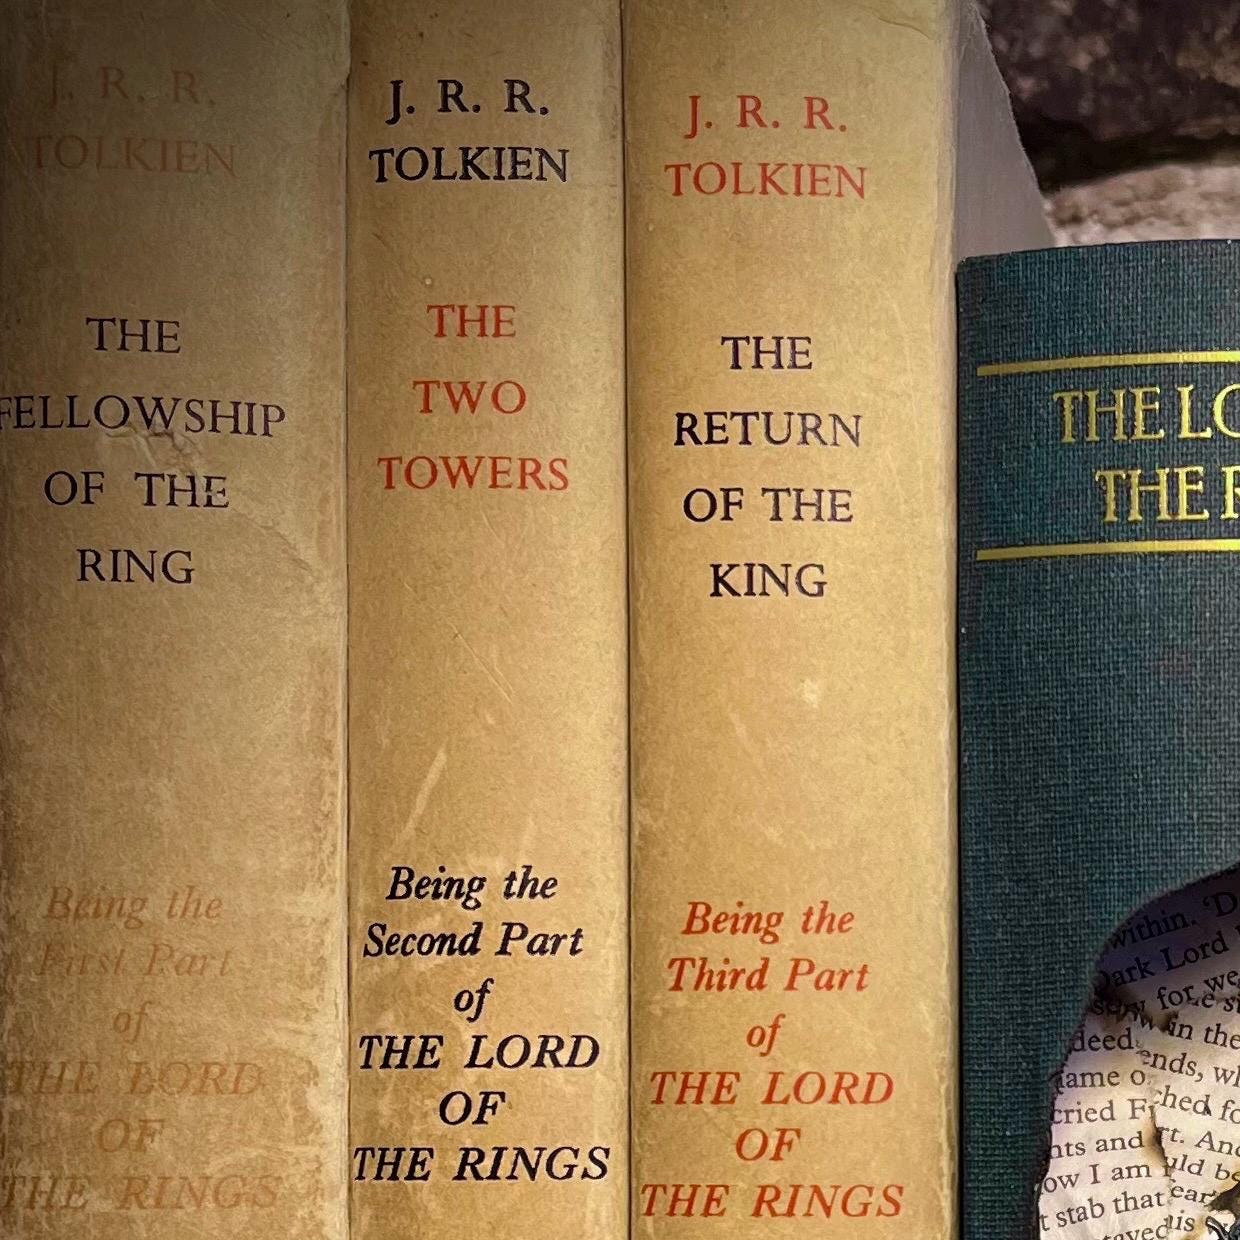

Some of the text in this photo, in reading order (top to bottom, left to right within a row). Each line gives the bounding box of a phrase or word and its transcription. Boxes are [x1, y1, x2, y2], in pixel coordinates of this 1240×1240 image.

[385, 79, 549, 125] J. R. R.
[685, 94, 847, 139] J. R. R.
[34, 135, 237, 176] TOLKIEN
[369, 146, 568, 183] TOLKIEN
[664, 162, 867, 199] TOLKIEN
[86, 317, 181, 355] THE
[426, 304, 517, 338] THE
[721, 335, 813, 371] THE
[412, 380, 526, 415] TWO
[1053, 386, 1165, 444] THE
[673, 411, 862, 447] RETURN
[43, 470, 229, 510] OF THE
[377, 456, 568, 491] TOWERS
[683, 487, 853, 523] OF THE
[1095, 466, 1209, 525] THE
[76, 548, 195, 584] RING
[709, 562, 827, 598] KING
[386, 866, 559, 911] Being the
[47, 886, 222, 928] Being the
[681, 901, 855, 944] Being the
[363, 922, 584, 958] Second Part
[1111, 909, 1198, 950] within.
[38, 943, 234, 978] First Part
[1160, 930, 1230, 971] Lord
[667, 957, 869, 992] Third Part
[453, 977, 494, 1021] of
[1157, 986, 1194, 1010] for
[112, 1003, 150, 1043] of
[746, 1013, 786, 1057] of
[359, 1034, 600, 1070] THE LORD
[7, 1062, 264, 1096] THE LORD
[650, 1071, 894, 1105] THE LORD
[438, 1091, 505, 1125] OF
[99, 1118, 164, 1153] OF
[735, 1128, 800, 1161] OF
[1096, 1131, 1145, 1153] and
[353, 1145, 610, 1182] THE RINGS
[1089, 1163, 1101, 1185] I
[1111, 1162, 1152, 1182] am
[2, 1176, 281, 1210] THE RINGS
[640, 1183, 905, 1218] THE RINGS
[1056, 1198, 1106, 1229] stab
[1112, 1190, 1165, 1214] that
